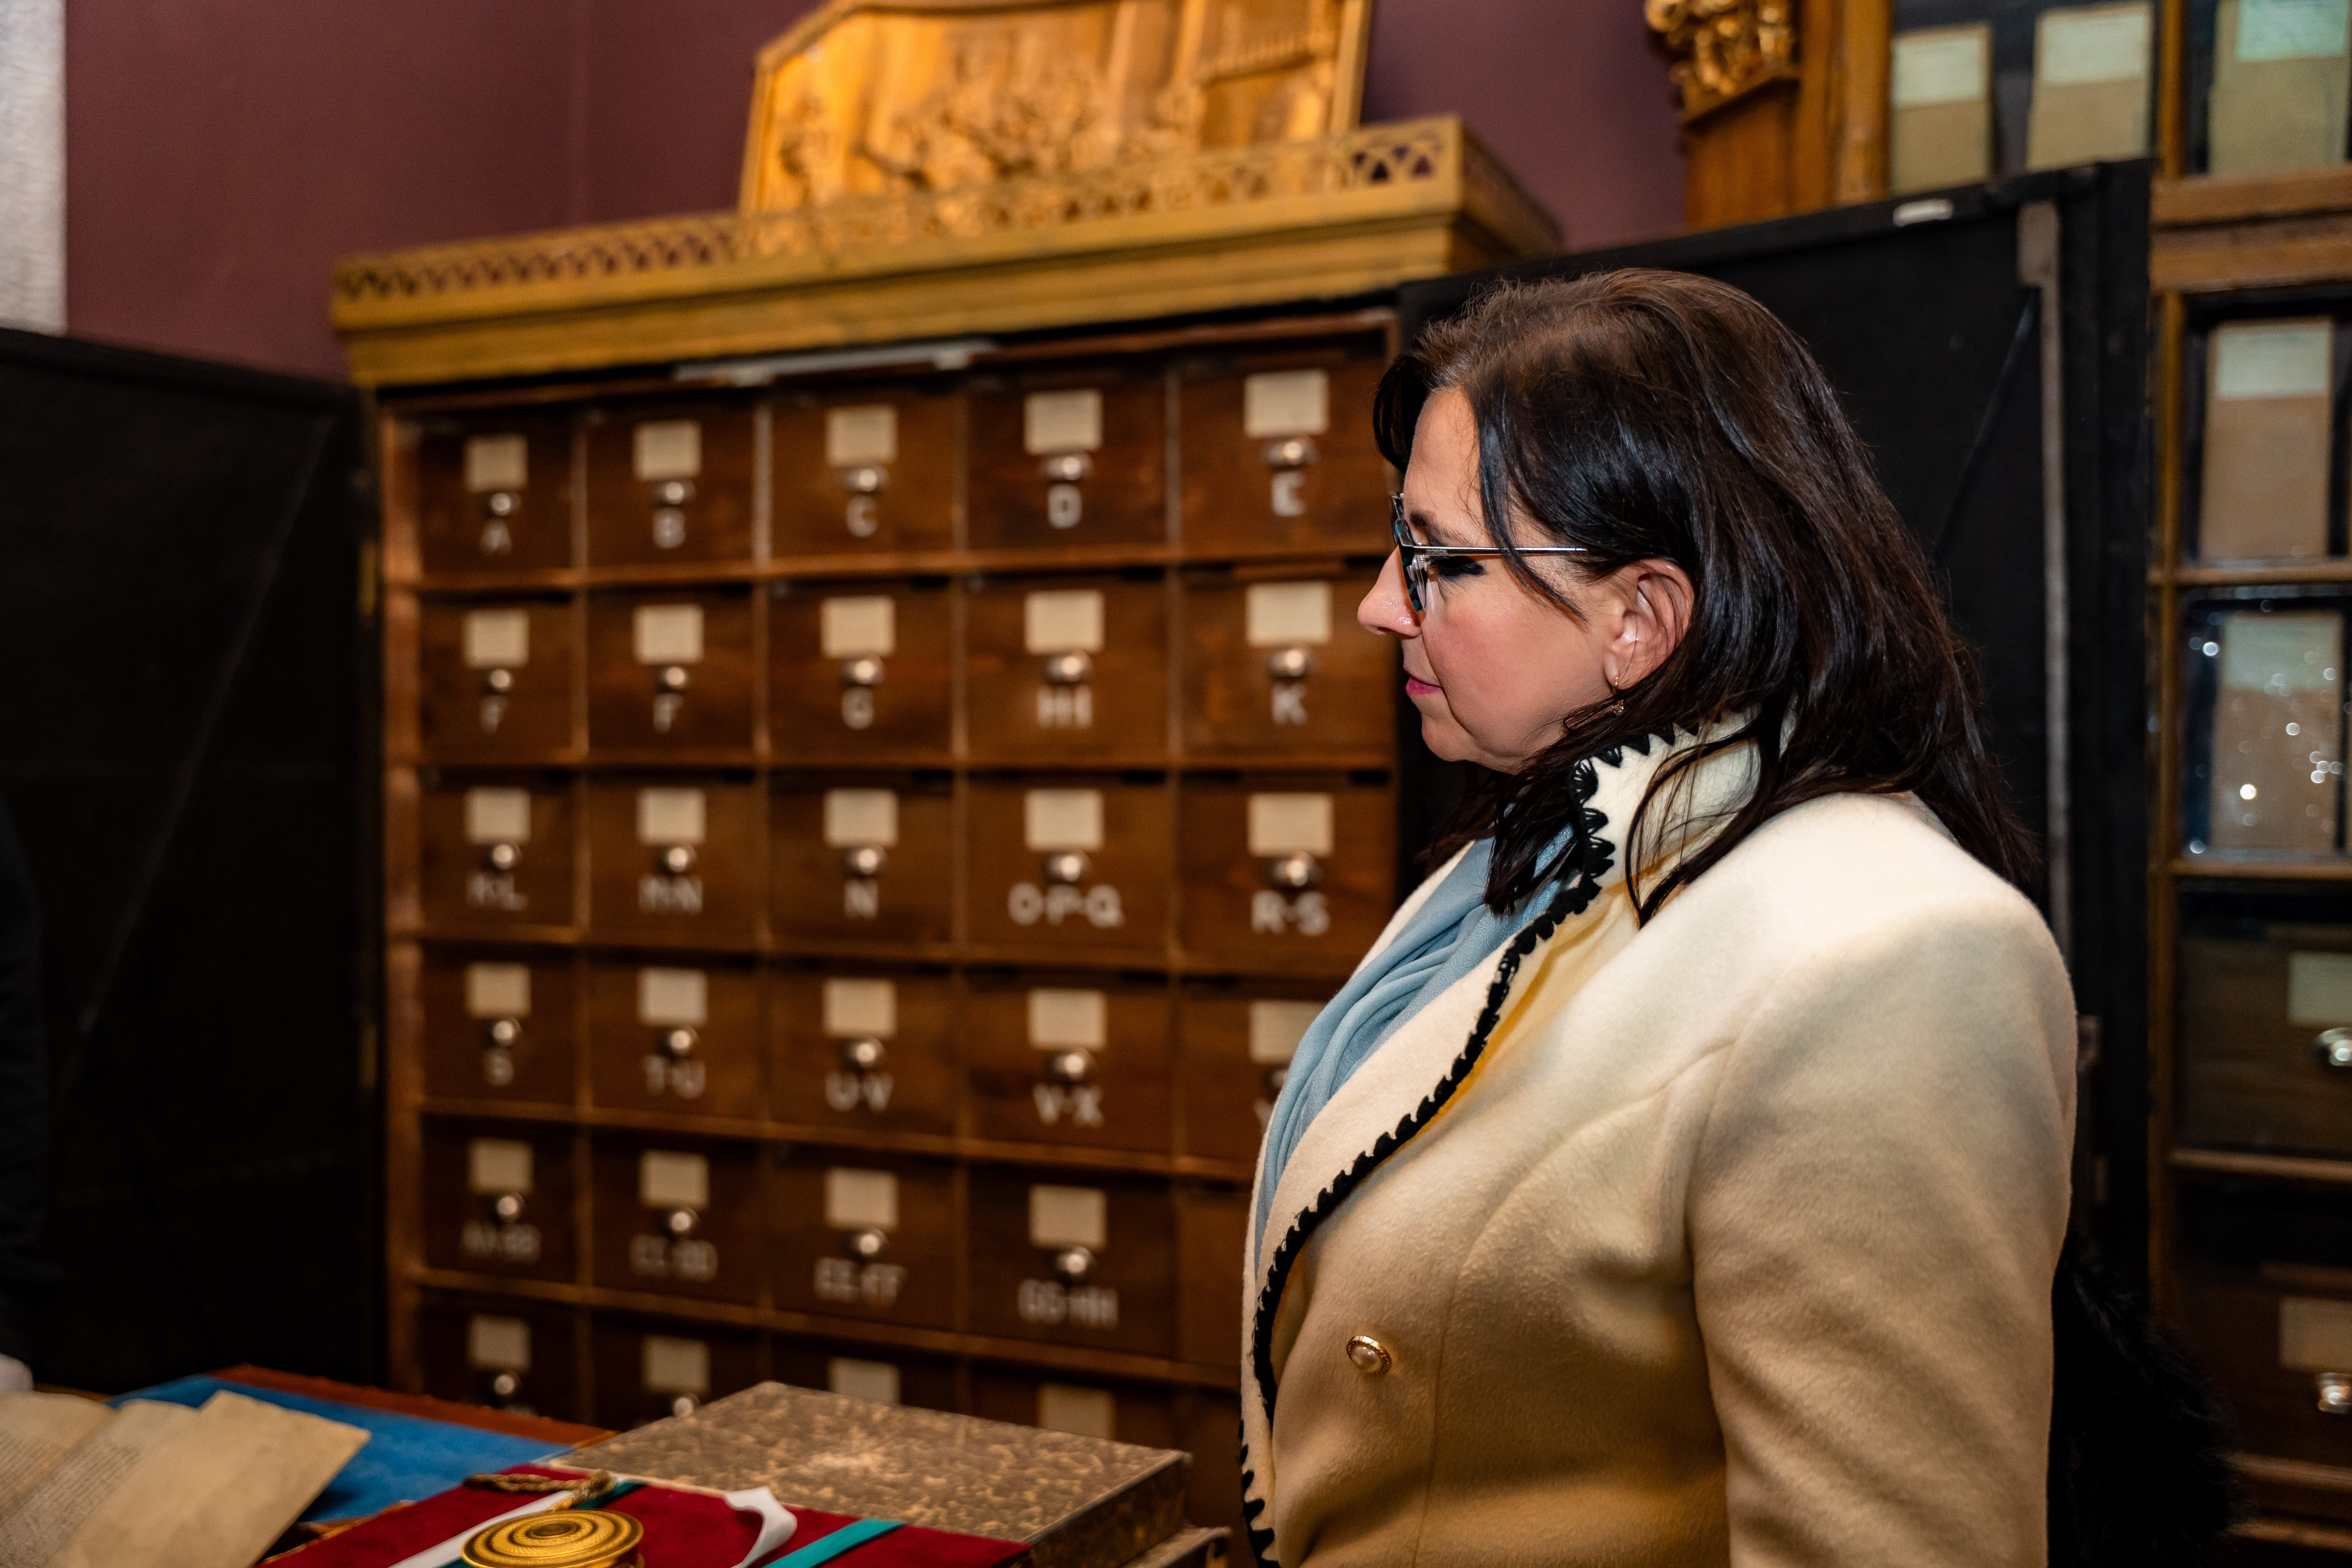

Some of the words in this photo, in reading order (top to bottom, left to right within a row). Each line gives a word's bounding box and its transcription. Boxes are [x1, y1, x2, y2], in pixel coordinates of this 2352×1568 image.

[1047, 485, 1082, 528] D
[1271, 472, 1306, 516] E
[652, 509, 685, 548] B
[846, 495, 878, 537] C
[480, 521, 511, 555] A
[842, 688, 874, 729] G
[1271, 682, 1308, 726] K
[844, 880, 878, 919] N
[1252, 890, 1330, 936] R-S
